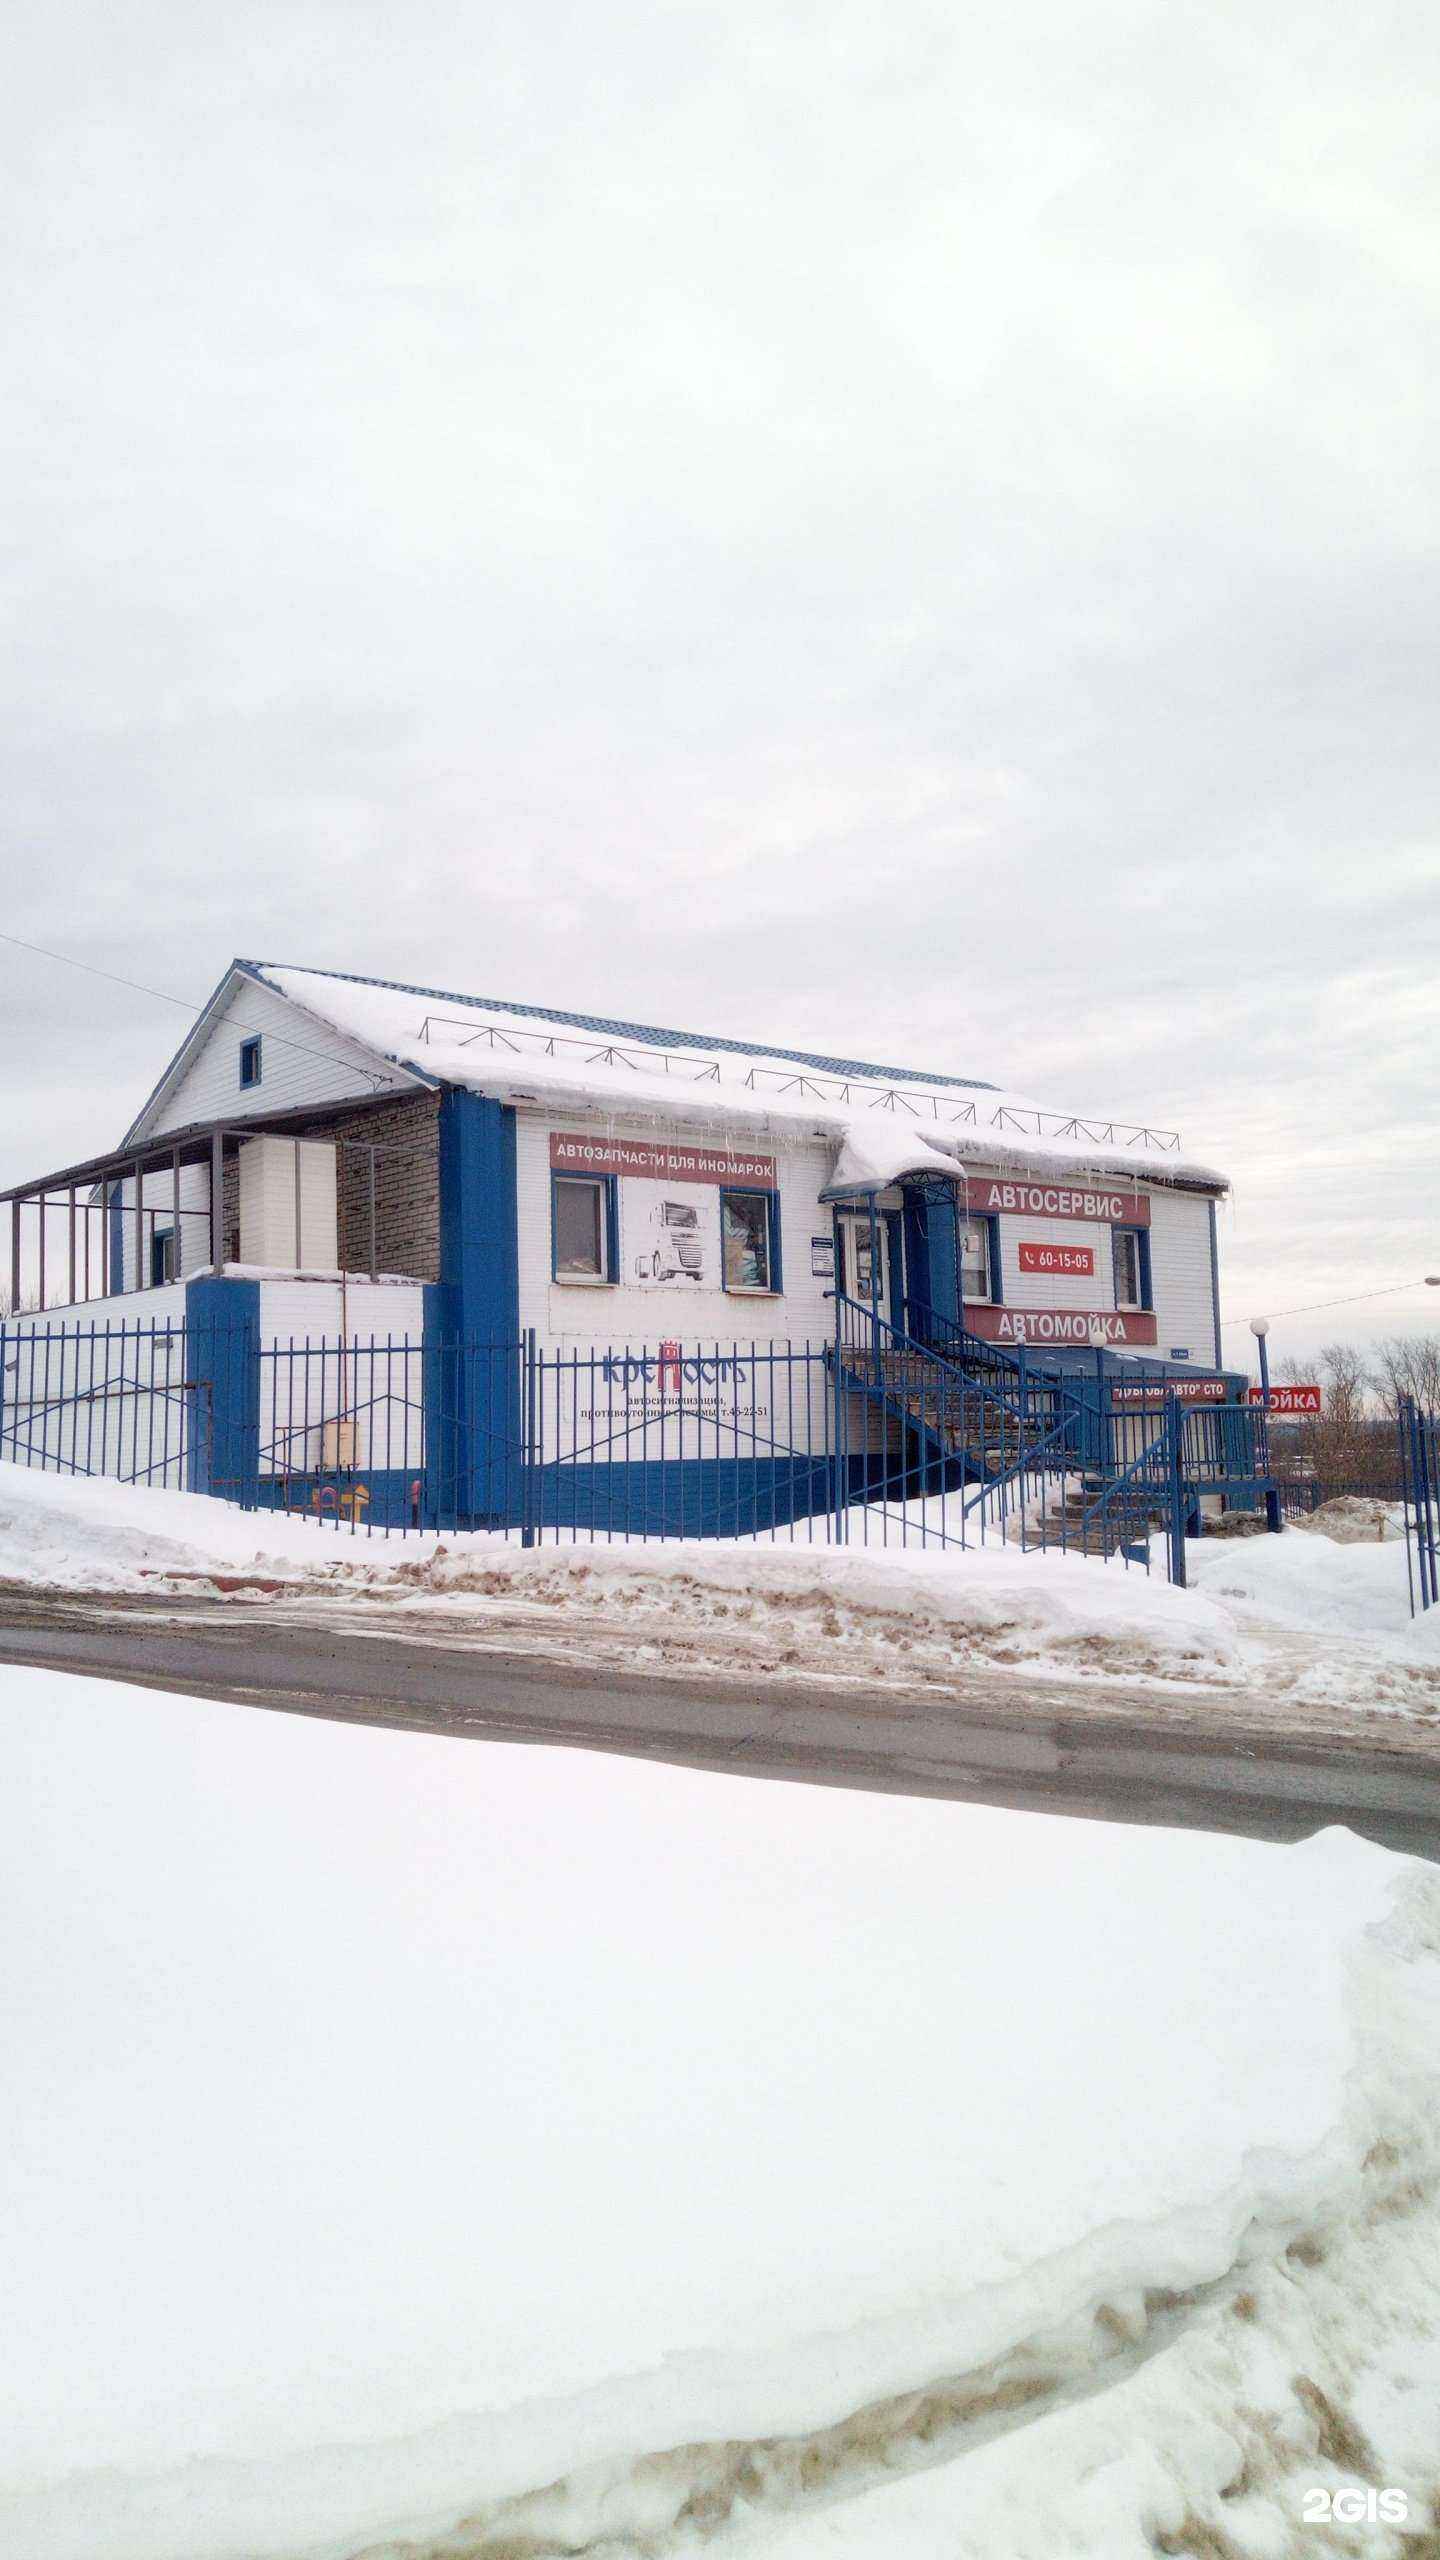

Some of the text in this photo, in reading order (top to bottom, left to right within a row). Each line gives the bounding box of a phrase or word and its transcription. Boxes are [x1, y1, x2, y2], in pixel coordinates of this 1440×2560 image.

[556, 1143, 772, 1177] АВТОЗАПЧАСТИ ДЛЯ ИНОМАРОК
[988, 1184, 1123, 1219] АВТОСЕРВИС
[1039, 1251, 1089, 1269] 60-15-05
[998, 1312, 1127, 1340] АВТОМОЙКА
[1203, 1383, 1224, 1396] СТО
[1252, 1391, 1318, 1410] МОЙКА
